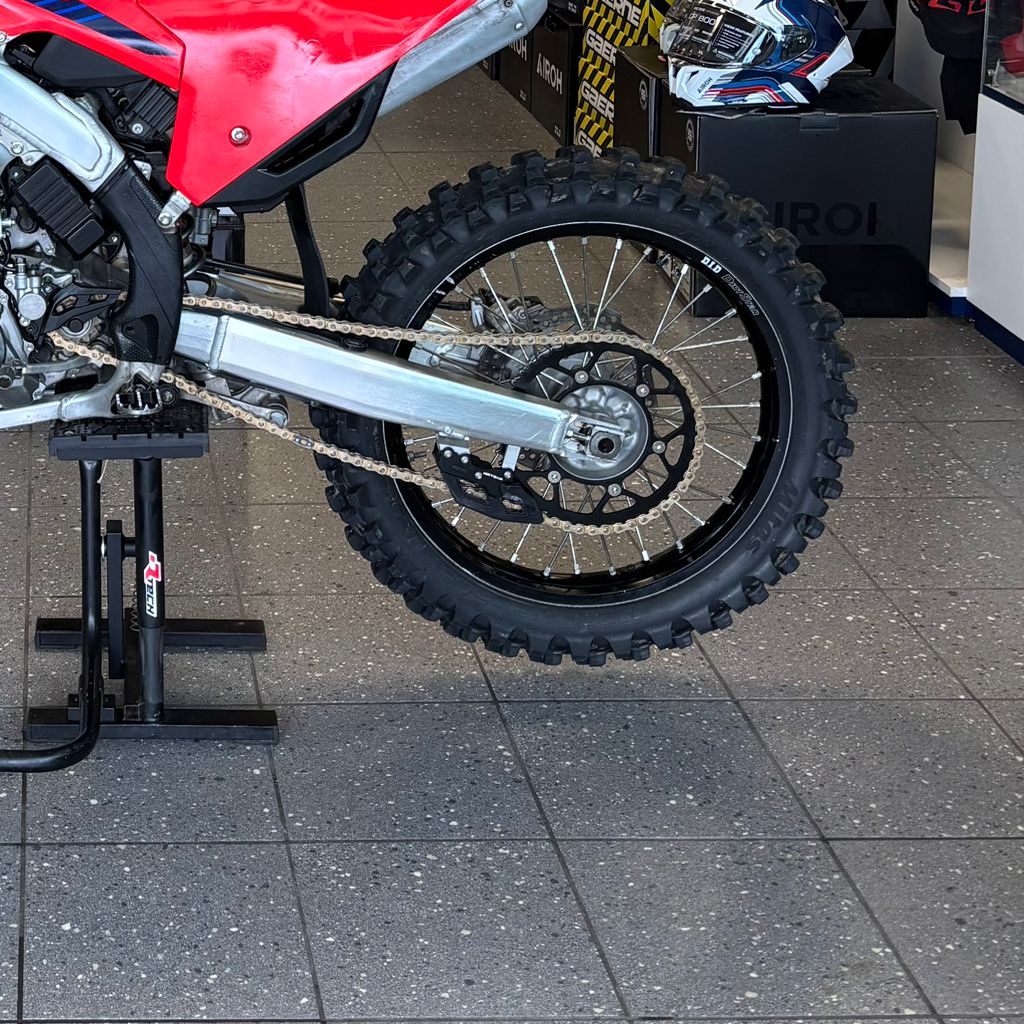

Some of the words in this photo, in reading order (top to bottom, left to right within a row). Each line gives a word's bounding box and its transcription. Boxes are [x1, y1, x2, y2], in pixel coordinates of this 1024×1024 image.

[698, 15, 716, 26] 800
[537, 53, 563, 95] AIROH
[698, 77, 713, 94] AIROH
[581, 79, 615, 123] GAER
